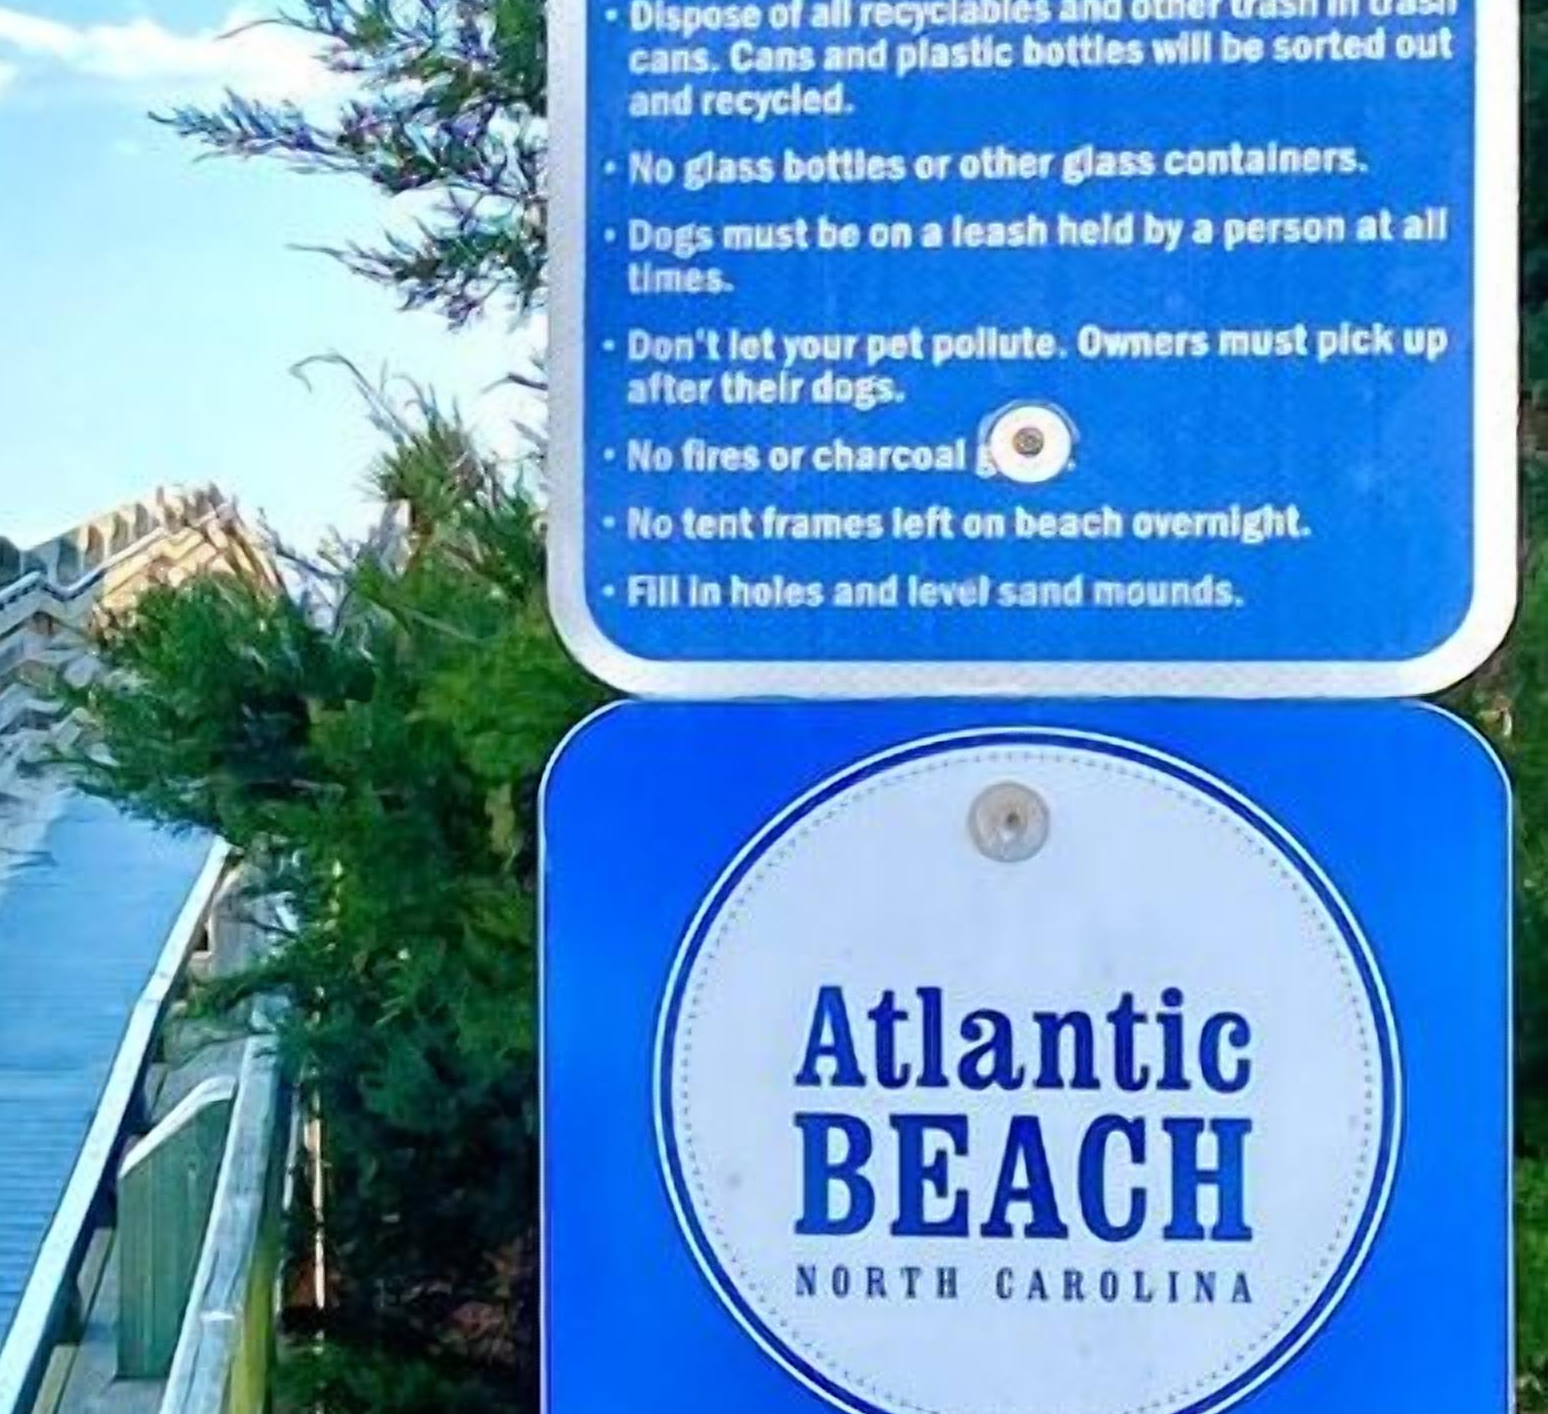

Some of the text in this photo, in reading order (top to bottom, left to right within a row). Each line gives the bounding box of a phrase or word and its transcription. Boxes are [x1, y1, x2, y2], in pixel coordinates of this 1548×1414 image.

[630, 0, 762, 35] Dispose
[629, 27, 1453, 75] cans. Cans and plastic bottles will be sorted out
[629, 82, 853, 122] and recycled.
[629, 142, 1367, 190] No glass bottles or other glass containers.
[629, 207, 1447, 258] Dogs must be on a leash held by a person at all
[628, 262, 733, 293] times.
[629, 323, 1448, 368] Don't let your pet pollute. Owners must pick up
[628, 370, 904, 410] after their dogs.
[628, 440, 673, 470] No
[682, 439, 760, 471] fires
[768, 447, 806, 471] or
[812, 438, 965, 471] charcoal
[628, 505, 1310, 544] No tent frames left on beach overnight.
[628, 575, 1243, 607] Fill in holes and level sand mounds.
[794, 986, 1250, 1093] Atlantic
[794, 1112, 1252, 1242] BEACH
[796, 1265, 1252, 1303] NORTH CAROLINA
